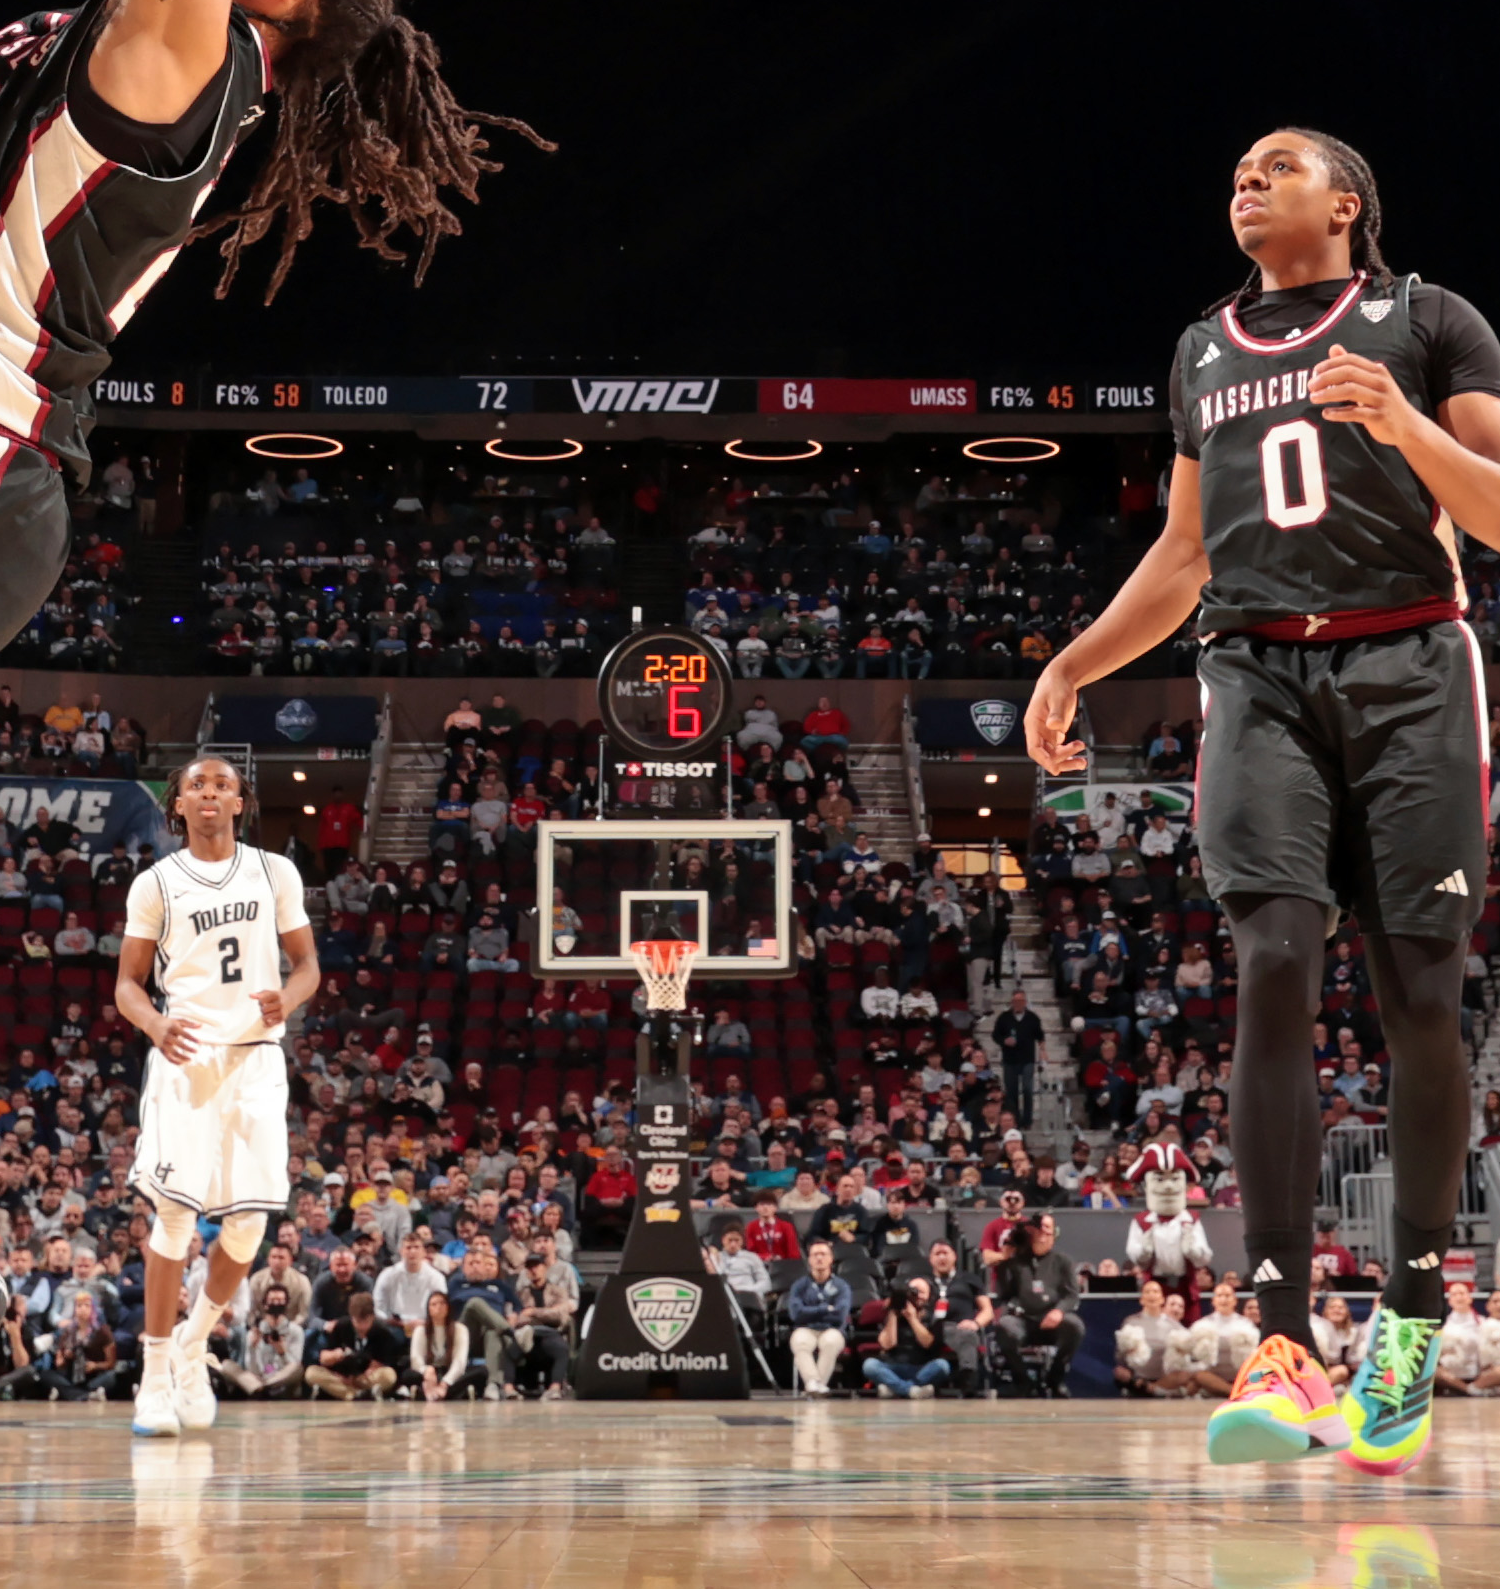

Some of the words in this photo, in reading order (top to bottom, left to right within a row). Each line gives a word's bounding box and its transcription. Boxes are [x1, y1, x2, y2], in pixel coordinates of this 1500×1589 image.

[95, 380, 156, 405] FOULS
[171, 382, 185, 406] 8
[217, 384, 260, 406] FG%
[274, 383, 300, 408] 58
[323, 386, 388, 406] TOLEDO
[478, 381, 508, 410] 72
[573, 378, 719, 414] MAC
[782, 382, 815, 410] 64
[910, 387, 967, 406] UMASS
[990, 387, 1035, 408] FG%
[1046, 385, 1074, 409] 45
[1095, 386, 1155, 408] FOULS
[1199, 368, 1319, 432] MASSACHU
[1258, 416, 1330, 532] 0
[643, 654, 708, 683] 2:20
[668, 685, 702, 738] 6
[188, 900, 259, 937] TOLEDO
[218, 936, 243, 984] 2
[632, 1299, 698, 1320] MAC
[597, 1352, 659, 1372] Credit
